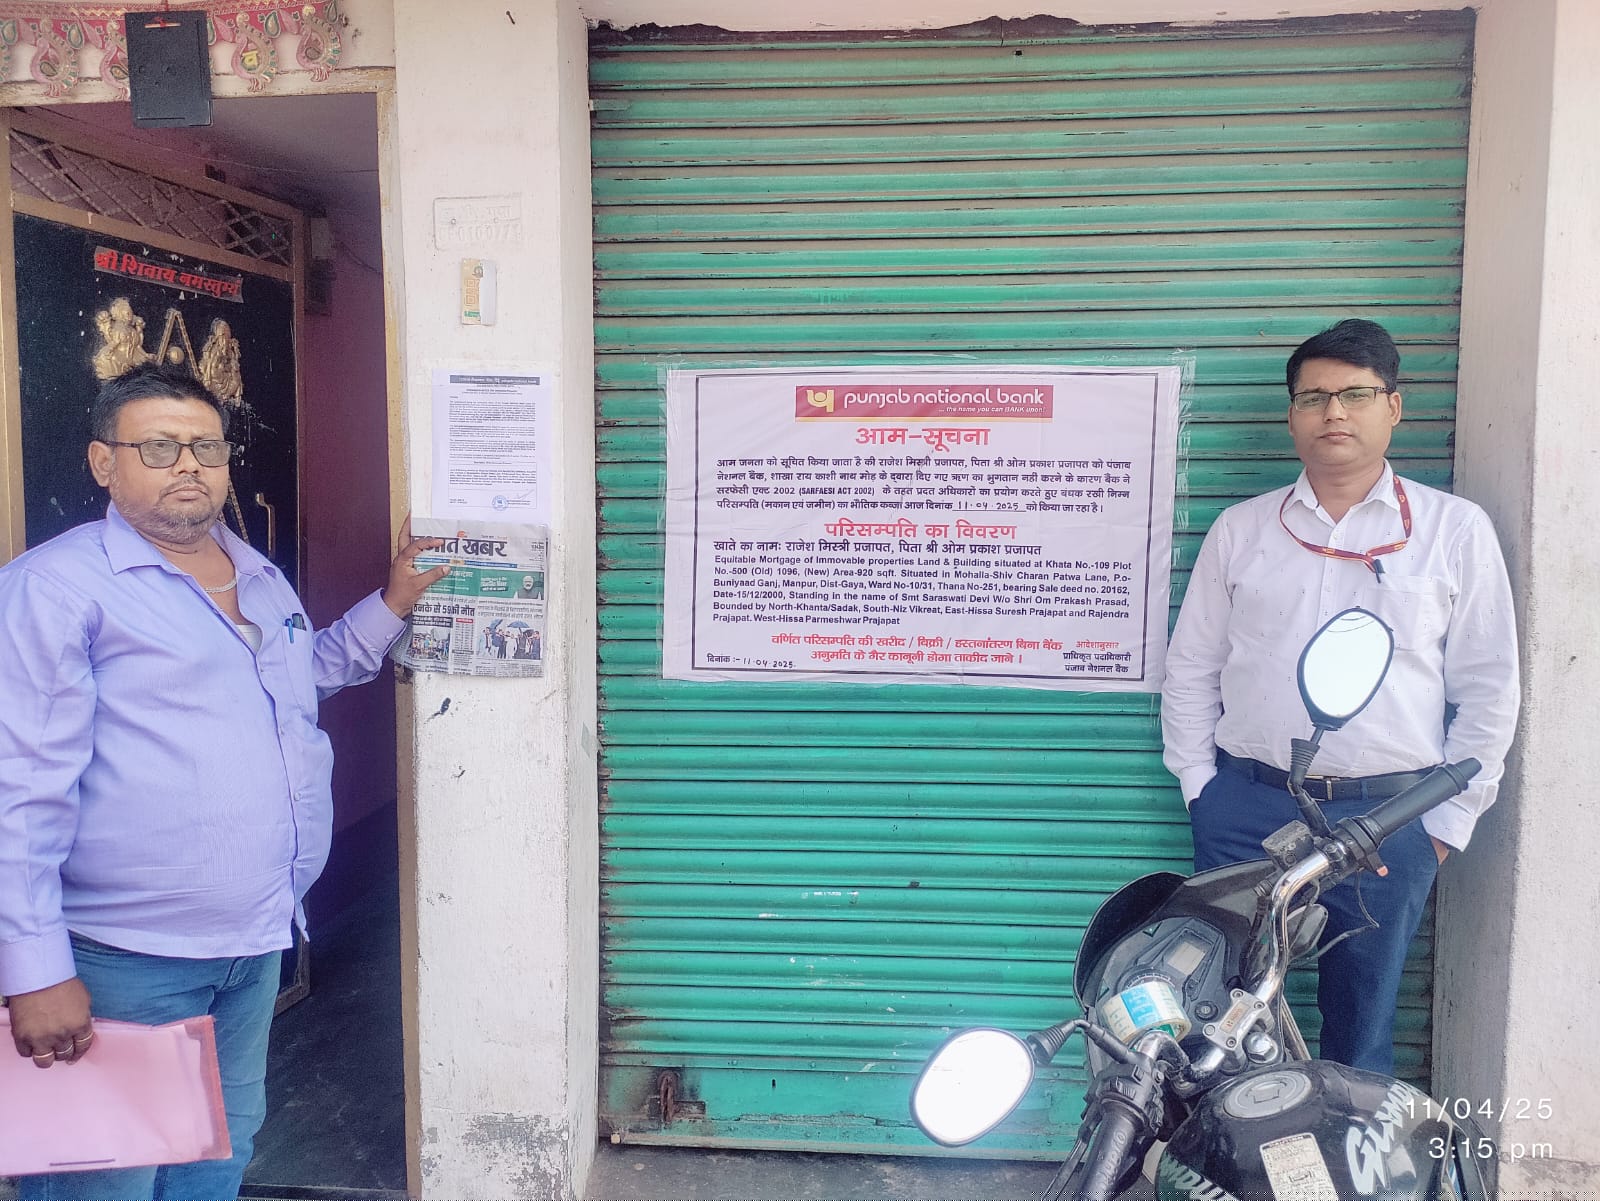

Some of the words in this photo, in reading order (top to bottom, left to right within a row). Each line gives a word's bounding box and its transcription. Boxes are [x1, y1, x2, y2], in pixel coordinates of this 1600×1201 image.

[844, 388, 909, 408] punjab
[914, 387, 994, 403] national
[996, 388, 1043, 403] bank
[856, 427, 990, 451] आम-सूचना
[824, 517, 917, 538] परिसम्पति
[924, 523, 949, 538] का
[955, 518, 1016, 539] विवरण
[462, 538, 507, 556] खबर
[713, 537, 736, 550] खाते
[740, 541, 753, 550] का
[785, 538, 814, 551] राजेश
[816, 538, 850, 551] मिस्त्री
[853, 542, 894, 554] प्रजापत,
[898, 540, 922, 552] पिता
[926, 540, 938, 553] श्री
[942, 540, 966, 553] ओम
[968, 544, 1000, 554] प्रकाश
[1004, 545, 1042, 555] प्रजापत
[715, 555, 755, 564] Equitable
[759, 555, 800, 565] Mortgage
[816, 555, 865, 564] Immovable
[868, 557, 914, 566] properties
[918, 557, 940, 565] Land
[953, 558, 990, 568] Building
[994, 559, 1030, 567] situated
[1046, 560, 1071, 568] Khata
[1075, 561, 1109, 569] No.-109
[1113, 561, 1131, 569] Plot
[751, 567, 772, 576] (Old)
[777, 567, 799, 576] 1096,
[804, 567, 829, 577] (New)
[832, 568, 873, 576] Area-920
[877, 569, 896, 578] sqft.
[900, 569, 937, 577] Situated
[942, 570, 950, 578] in
[954, 570, 1012, 579] Mohalla-Shiv
[1016, 571, 1048, 580] Charan
[1053, 572, 1080, 580] Patwa
[1084, 573, 1109, 582] Lane,
[714, 578, 755, 588] Buniyaad
[757, 579, 780, 588] Ganj,
[782, 579, 817, 589] Manpur,
[820, 579, 866, 589] Dist-Gaya,
[868, 580, 891, 588] Ward
[893, 581, 934, 590] No-10/31,
[937, 582, 964, 590] Thana
[967, 582, 1000, 592] No-251,
[1002, 583, 1036, 593] bearing
[1038, 584, 1058, 592] Sale
[1060, 584, 1082, 592] deed
[1100, 585, 1129, 595] 20162,
[713, 590, 785, 599] Date-15/12/2000,
[788, 590, 828, 601] Standing
[844, 592, 857, 600] the
[901, 593, 918, 601] Smt
[922, 593, 966, 602] Saraswati
[970, 594, 989, 602] Devi
[992, 595, 1010, 603] W/o
[1014, 595, 1032, 603] Shri
[1035, 595, 1050, 604] Om
[1054, 596, 1091, 605] Prakash
[1095, 597, 1129, 607] Prasad,
[755, 602, 766, 611] by
[768, 602, 860, 613] North-Khanta/Sadak,
[863, 604, 906, 612] South-Niz
[945, 606, 992, 614] East-Hissa
[994, 606, 1026, 615] Suresh
[1029, 607, 1066, 618] Prajapat
[1088, 609, 1128, 619] Rajendra
[753, 614, 803, 622] West-Hissa
[805, 615, 861, 623] Parmeshwar
[862, 616, 899, 626] Prajapat
